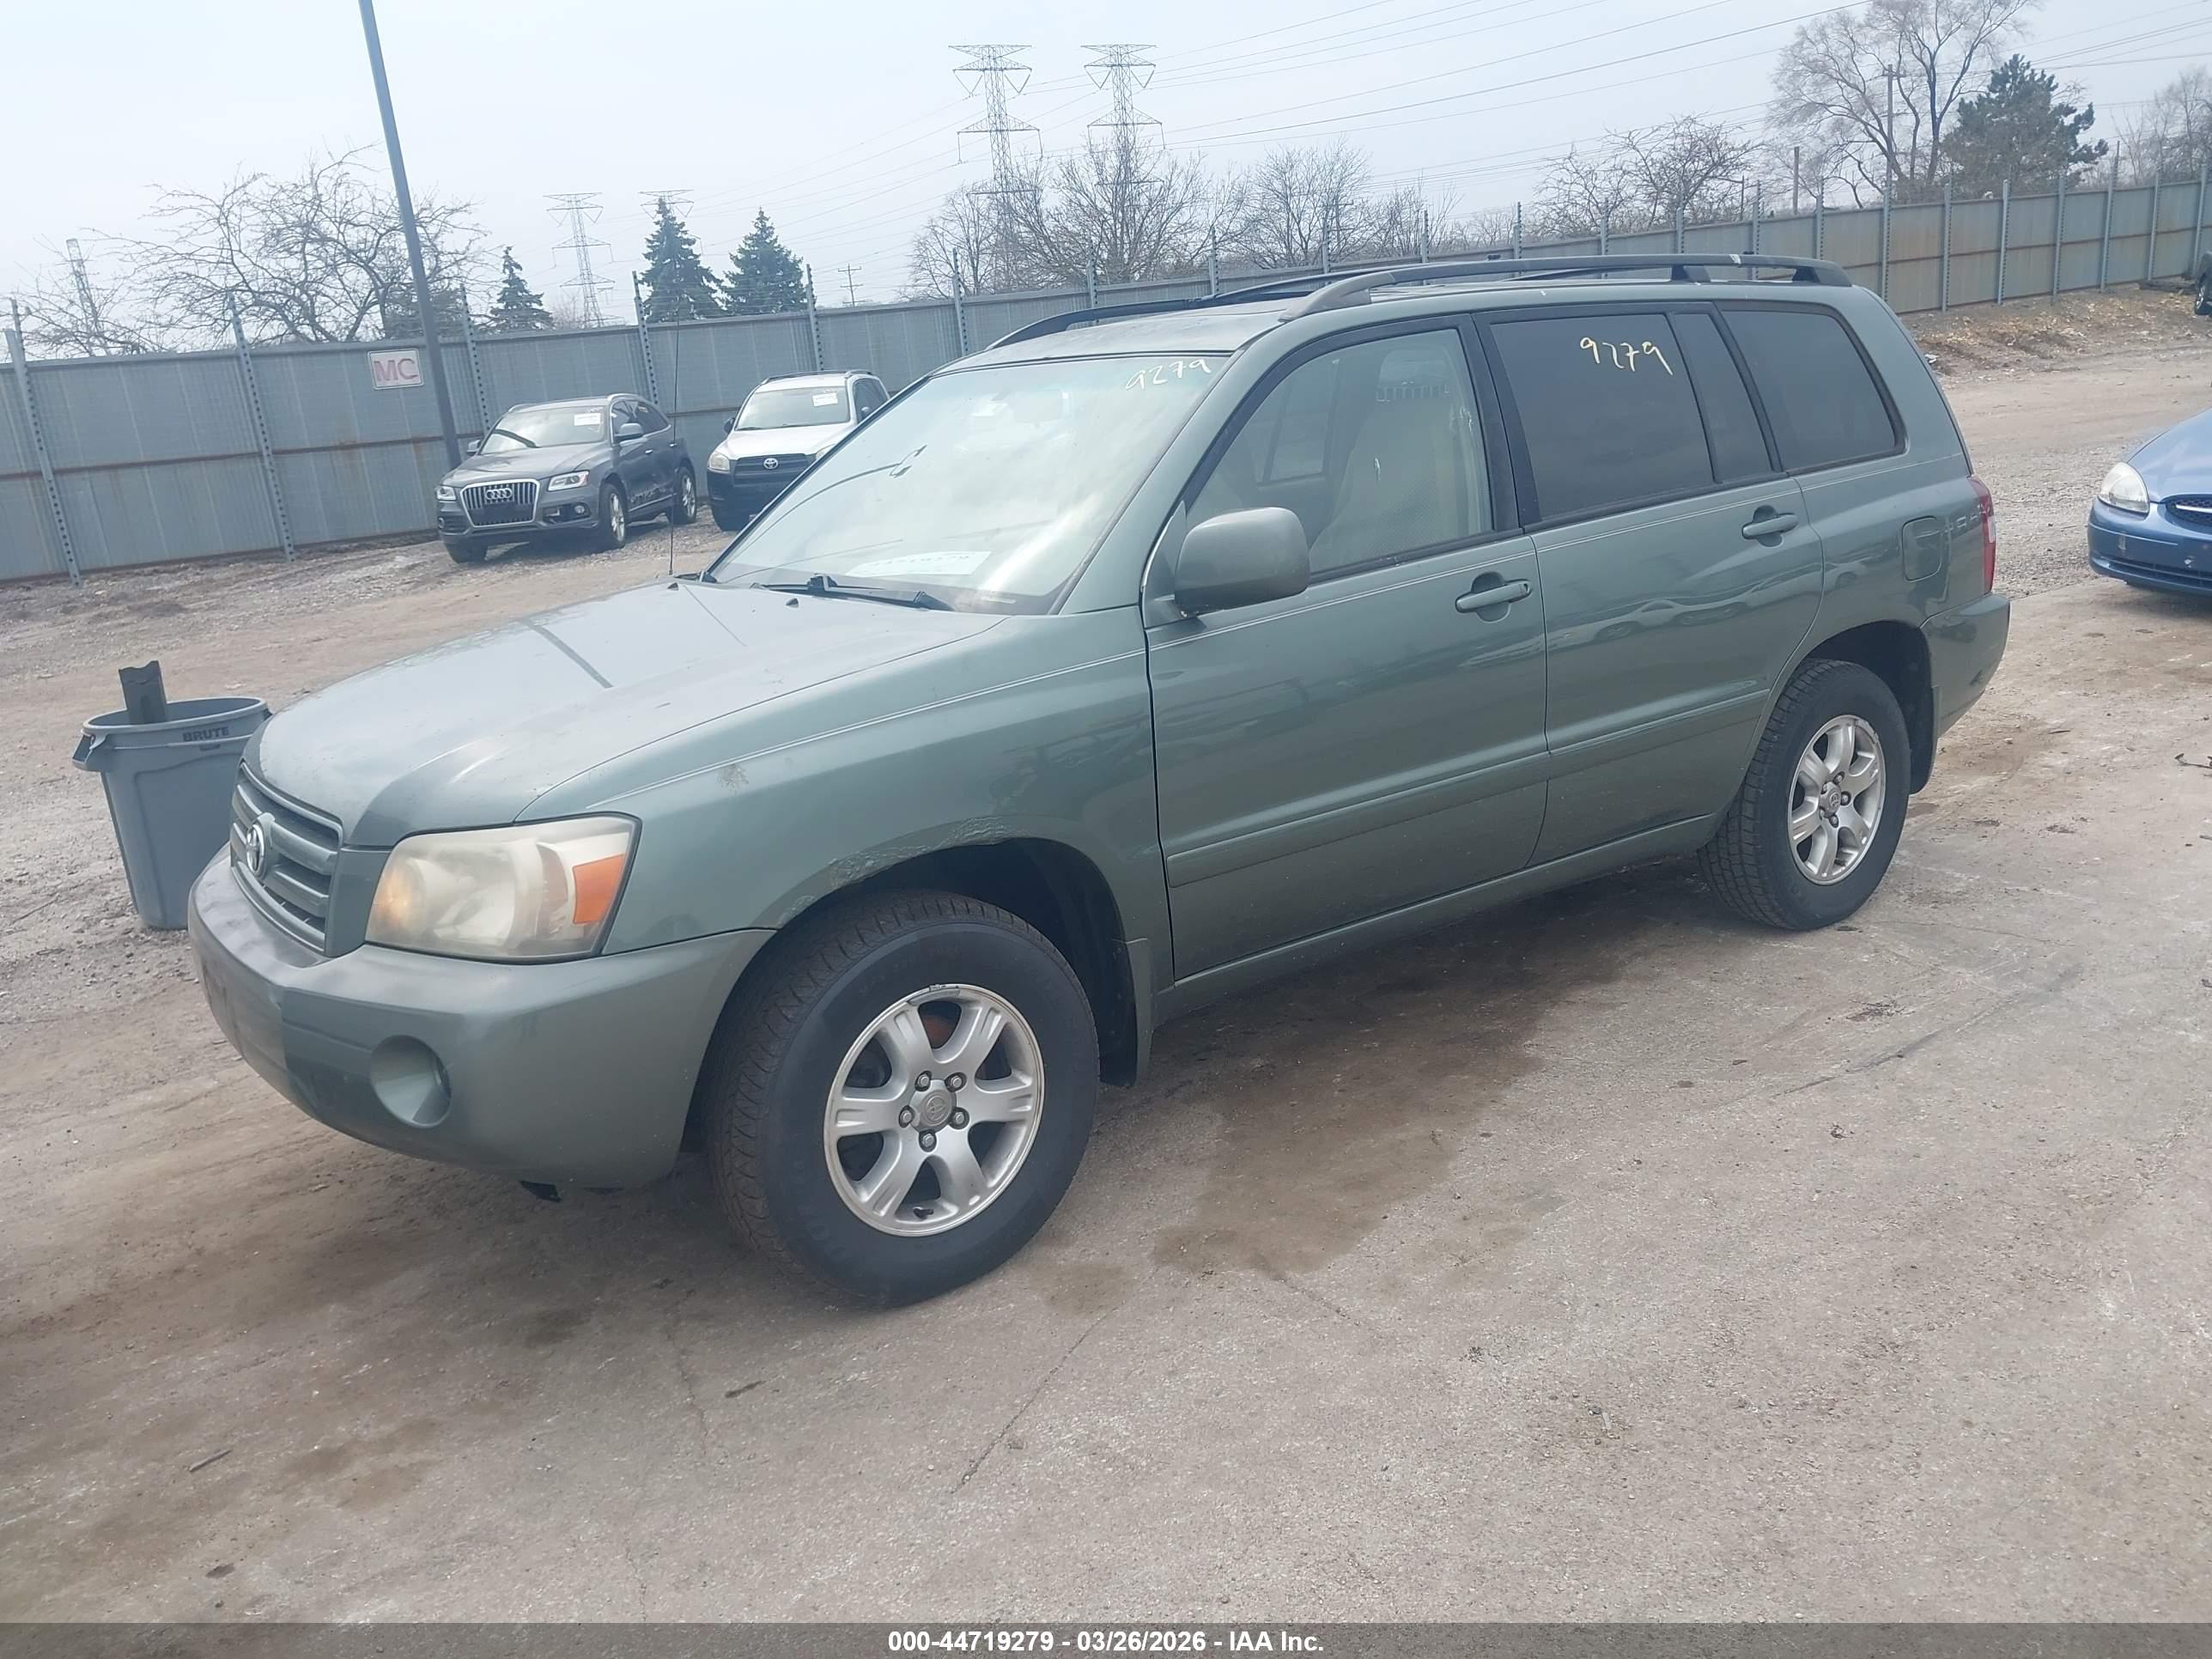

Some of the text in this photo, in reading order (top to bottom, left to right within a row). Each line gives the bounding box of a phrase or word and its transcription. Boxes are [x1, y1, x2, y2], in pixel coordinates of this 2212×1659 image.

[374, 358, 419, 382] MC
[1580, 337, 1674, 376] 9279
[1125, 358, 1212, 391] 9279
[182, 726, 230, 742] BRUTE
